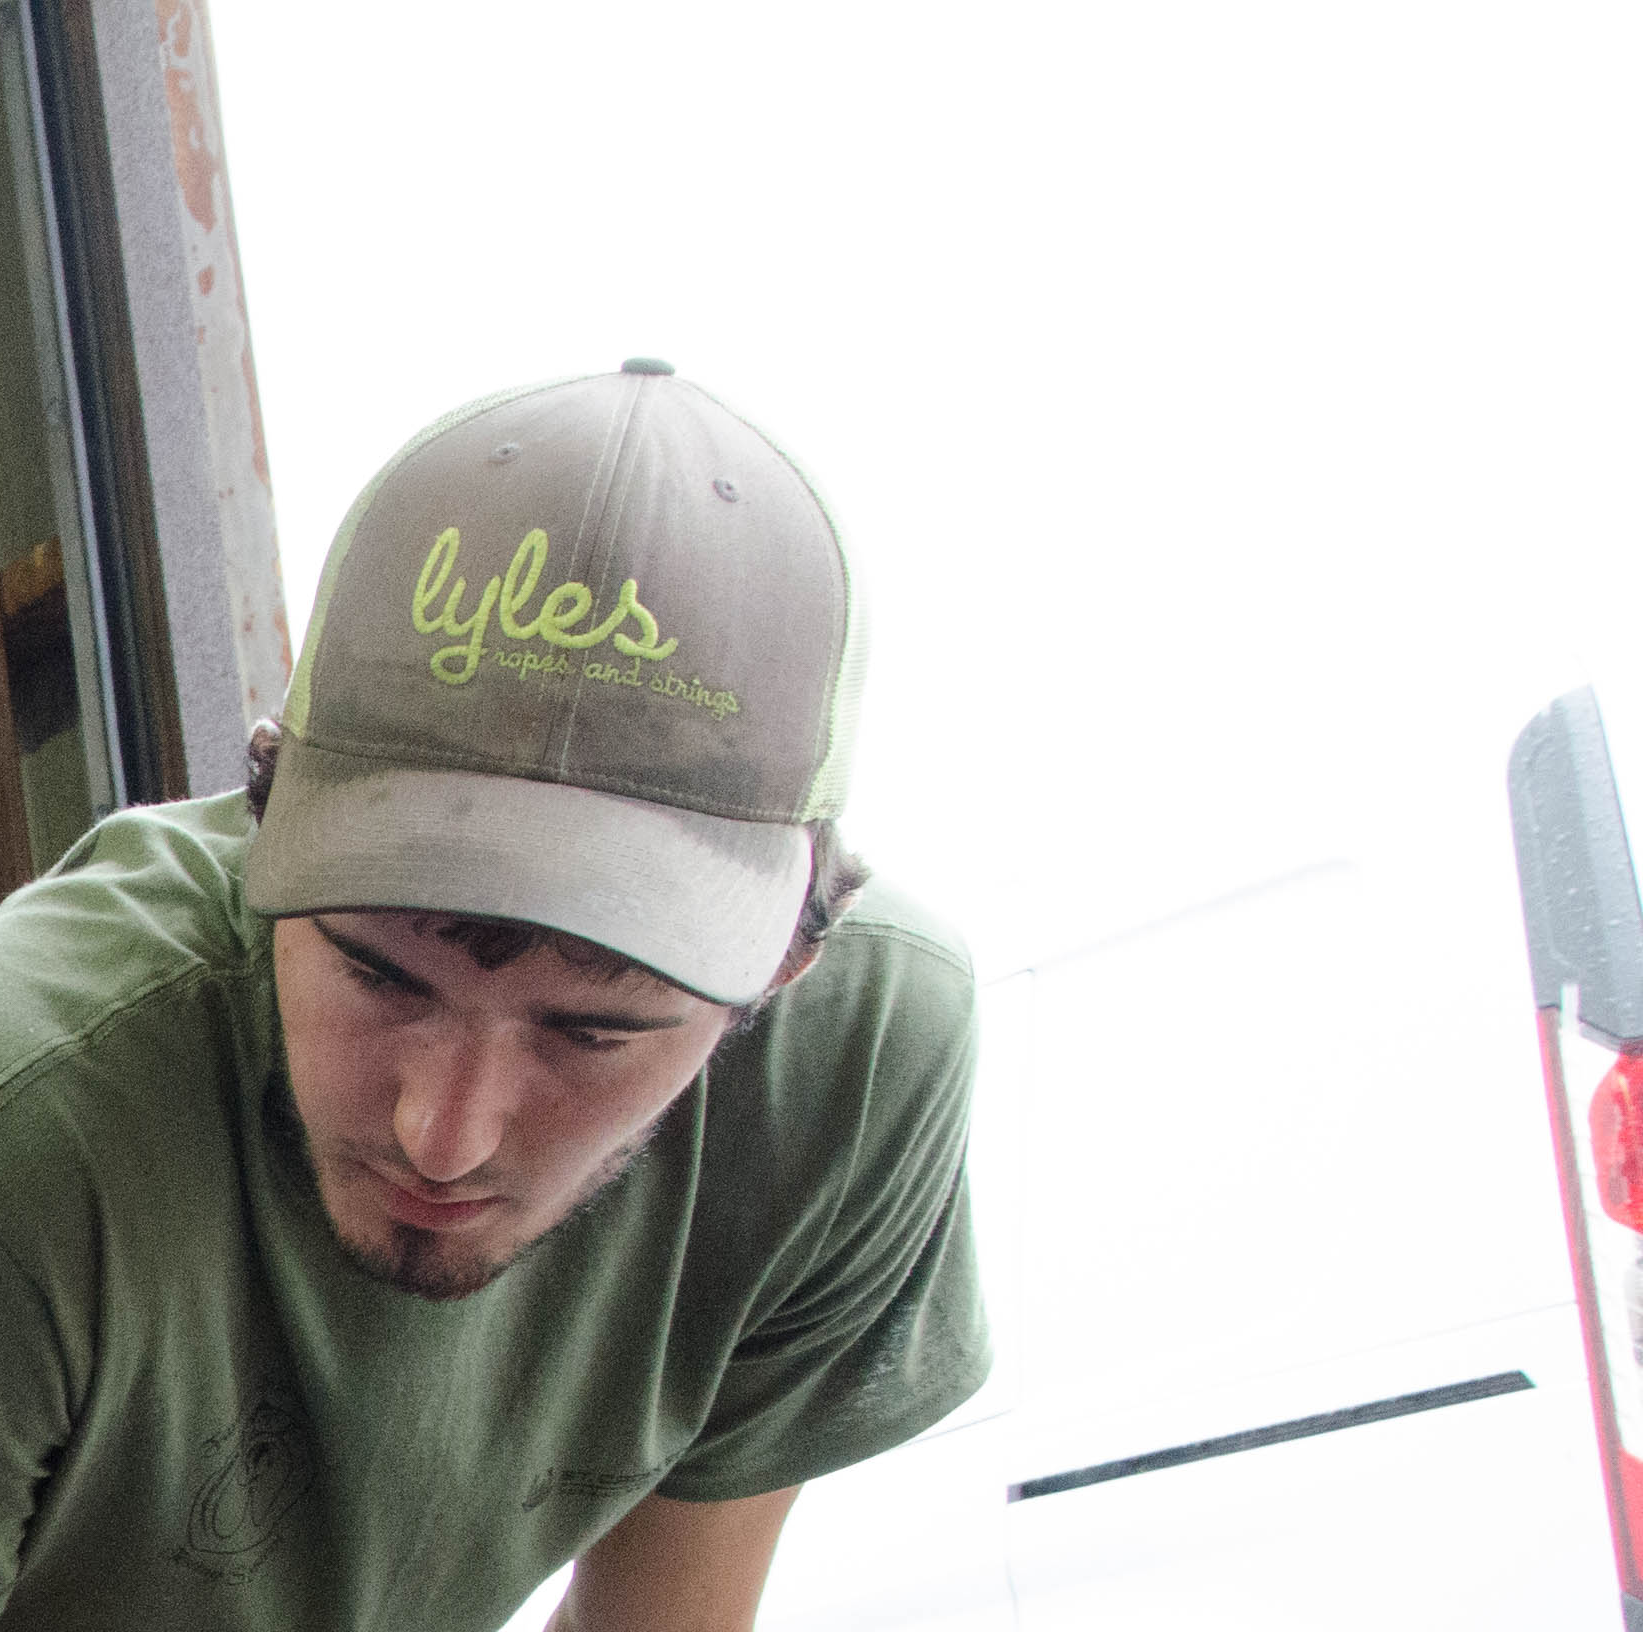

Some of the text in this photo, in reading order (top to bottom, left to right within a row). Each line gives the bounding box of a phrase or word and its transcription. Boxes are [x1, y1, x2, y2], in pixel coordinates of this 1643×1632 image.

[412, 526, 679, 686] lyles
[493, 649, 740, 722] ropes and strings
